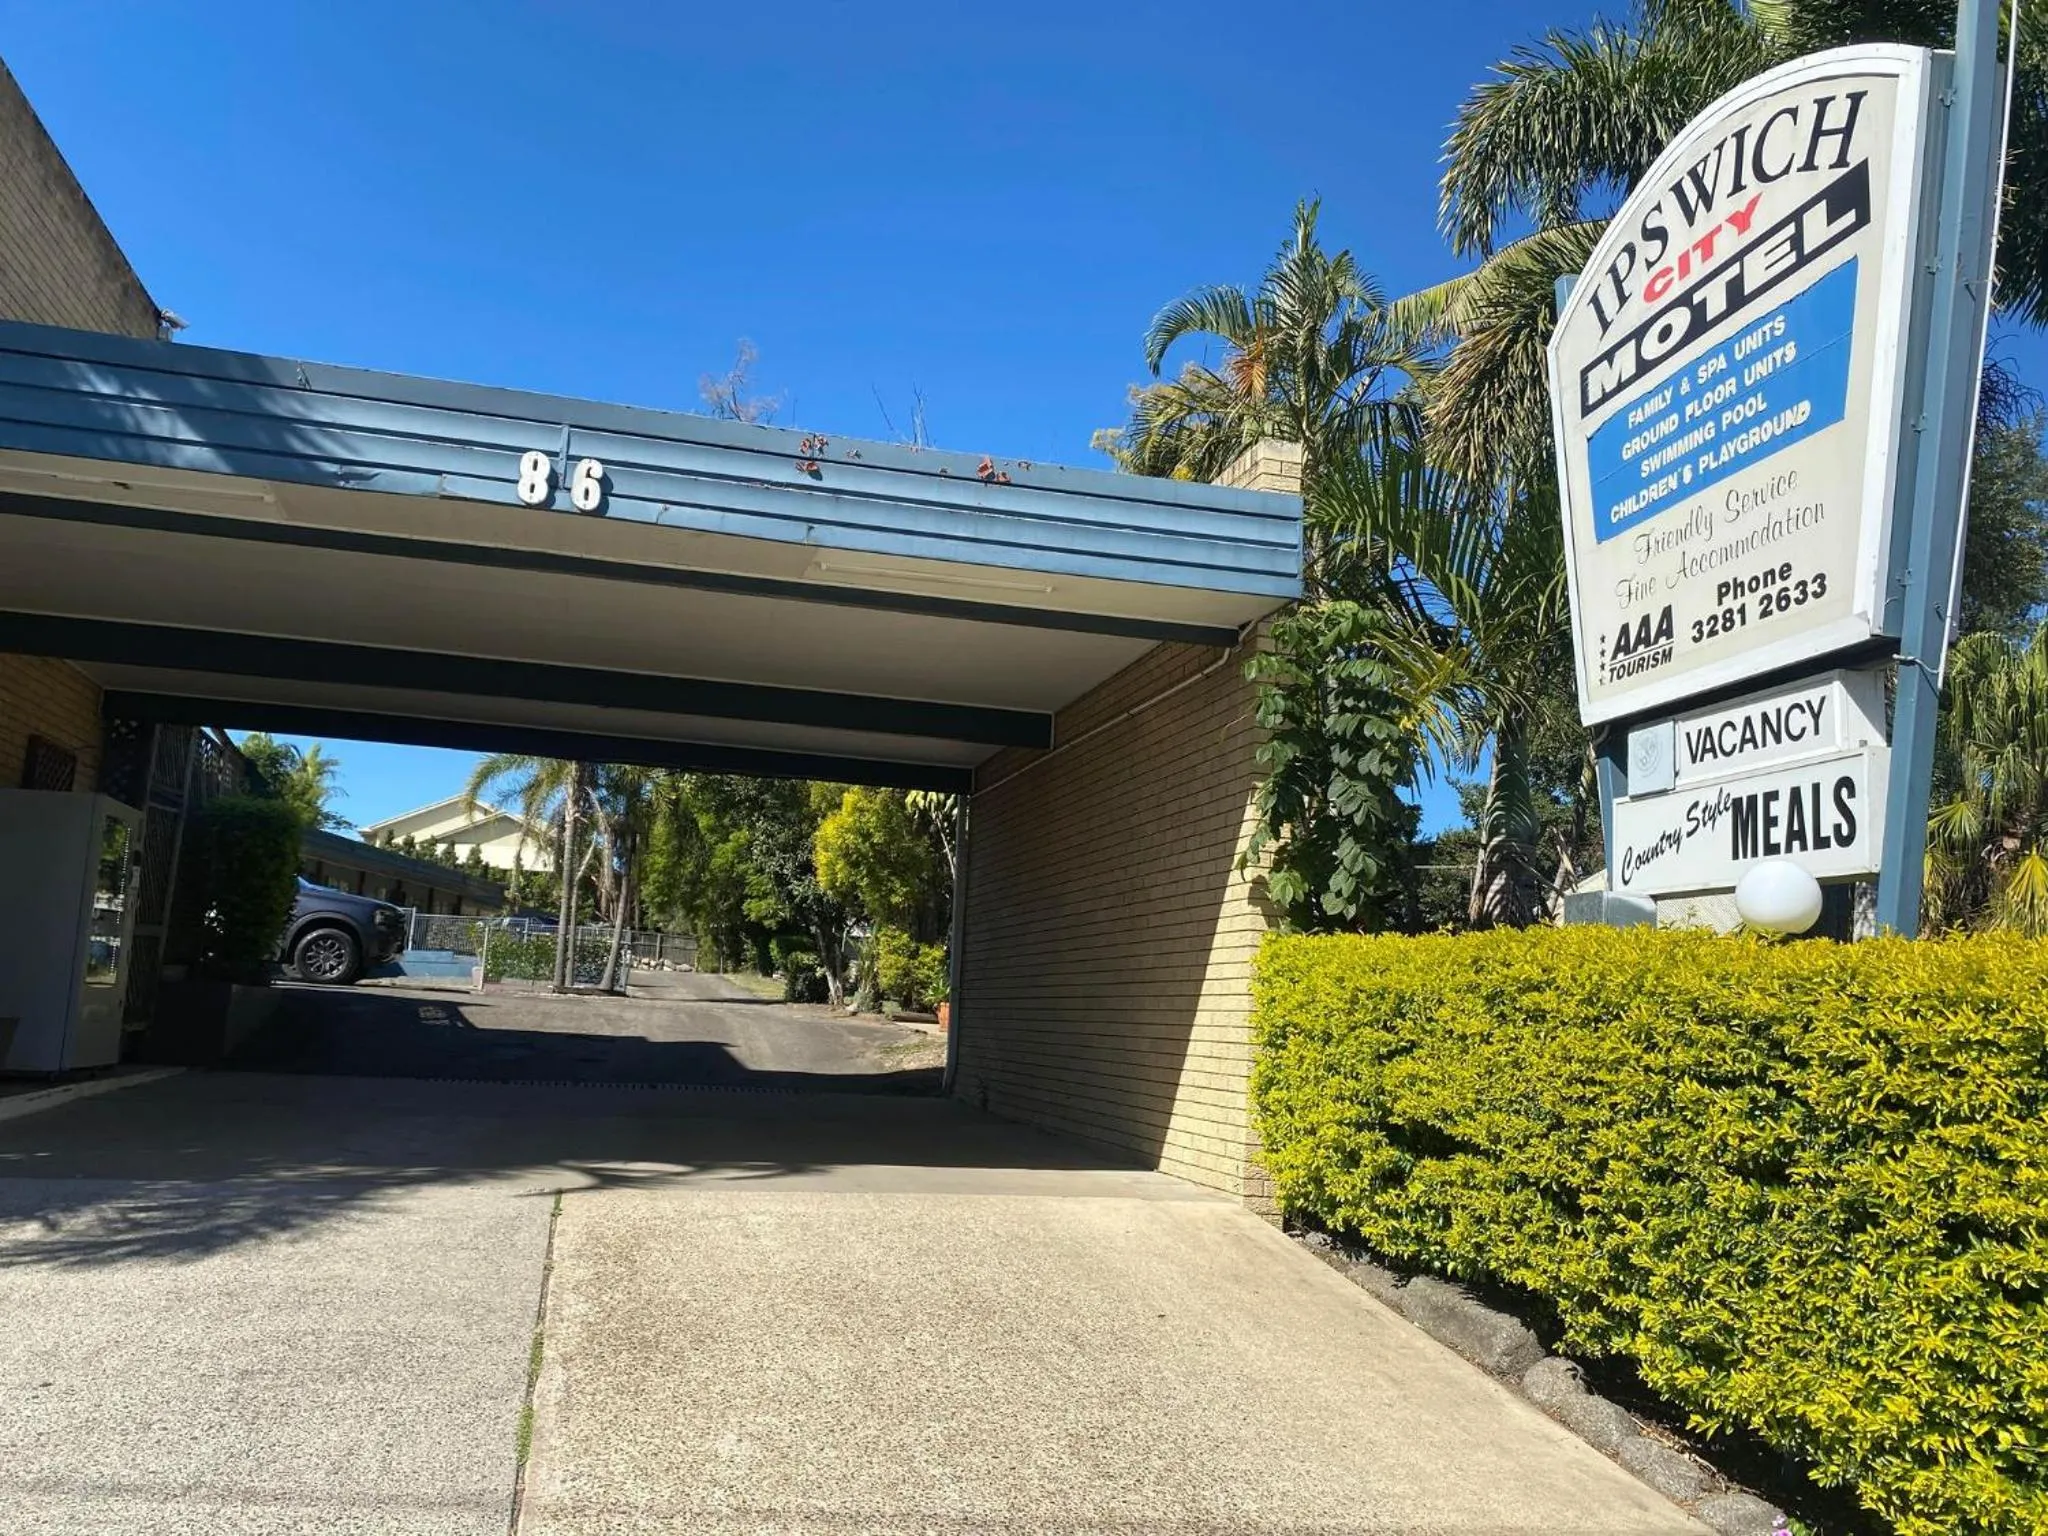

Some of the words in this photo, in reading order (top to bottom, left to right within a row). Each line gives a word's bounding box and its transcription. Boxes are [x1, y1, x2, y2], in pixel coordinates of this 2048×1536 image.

[1587, 90, 1868, 340] IPSWICH
[1643, 191, 1763, 303] CITY
[1584, 196, 1857, 406] MOTEL
[1622, 415, 1679, 460] GROUND
[1685, 377, 1737, 422] FLOOR
[1744, 341, 1796, 386] UNITS
[1628, 386, 1673, 429] FAMILY
[1680, 377, 1691, 394] &
[1697, 353, 1728, 384] SPA
[1734, 315, 1785, 359] UNITS
[1640, 420, 1716, 478] SWIMMING
[1722, 392, 1767, 431] POOL
[1699, 399, 1812, 474] PLAYGROUND
[517, 450, 604, 511] 86
[1633, 504, 1714, 565] Friendly
[1724, 470, 1798, 523] Service
[1616, 573, 1657, 609] Fine
[1665, 502, 1825, 590] Accommodation
[1717, 562, 1792, 606] Phone
[1610, 604, 1675, 662] AAA
[1691, 603, 1747, 644] 3281
[1758, 572, 1828, 620] 2633
[1609, 646, 1674, 683] TOURISM
[1686, 695, 1826, 764] VACANCY
[1621, 825, 1683, 886] Country
[1685, 786, 1732, 838] Style
[1731, 775, 1858, 861] MEALS
